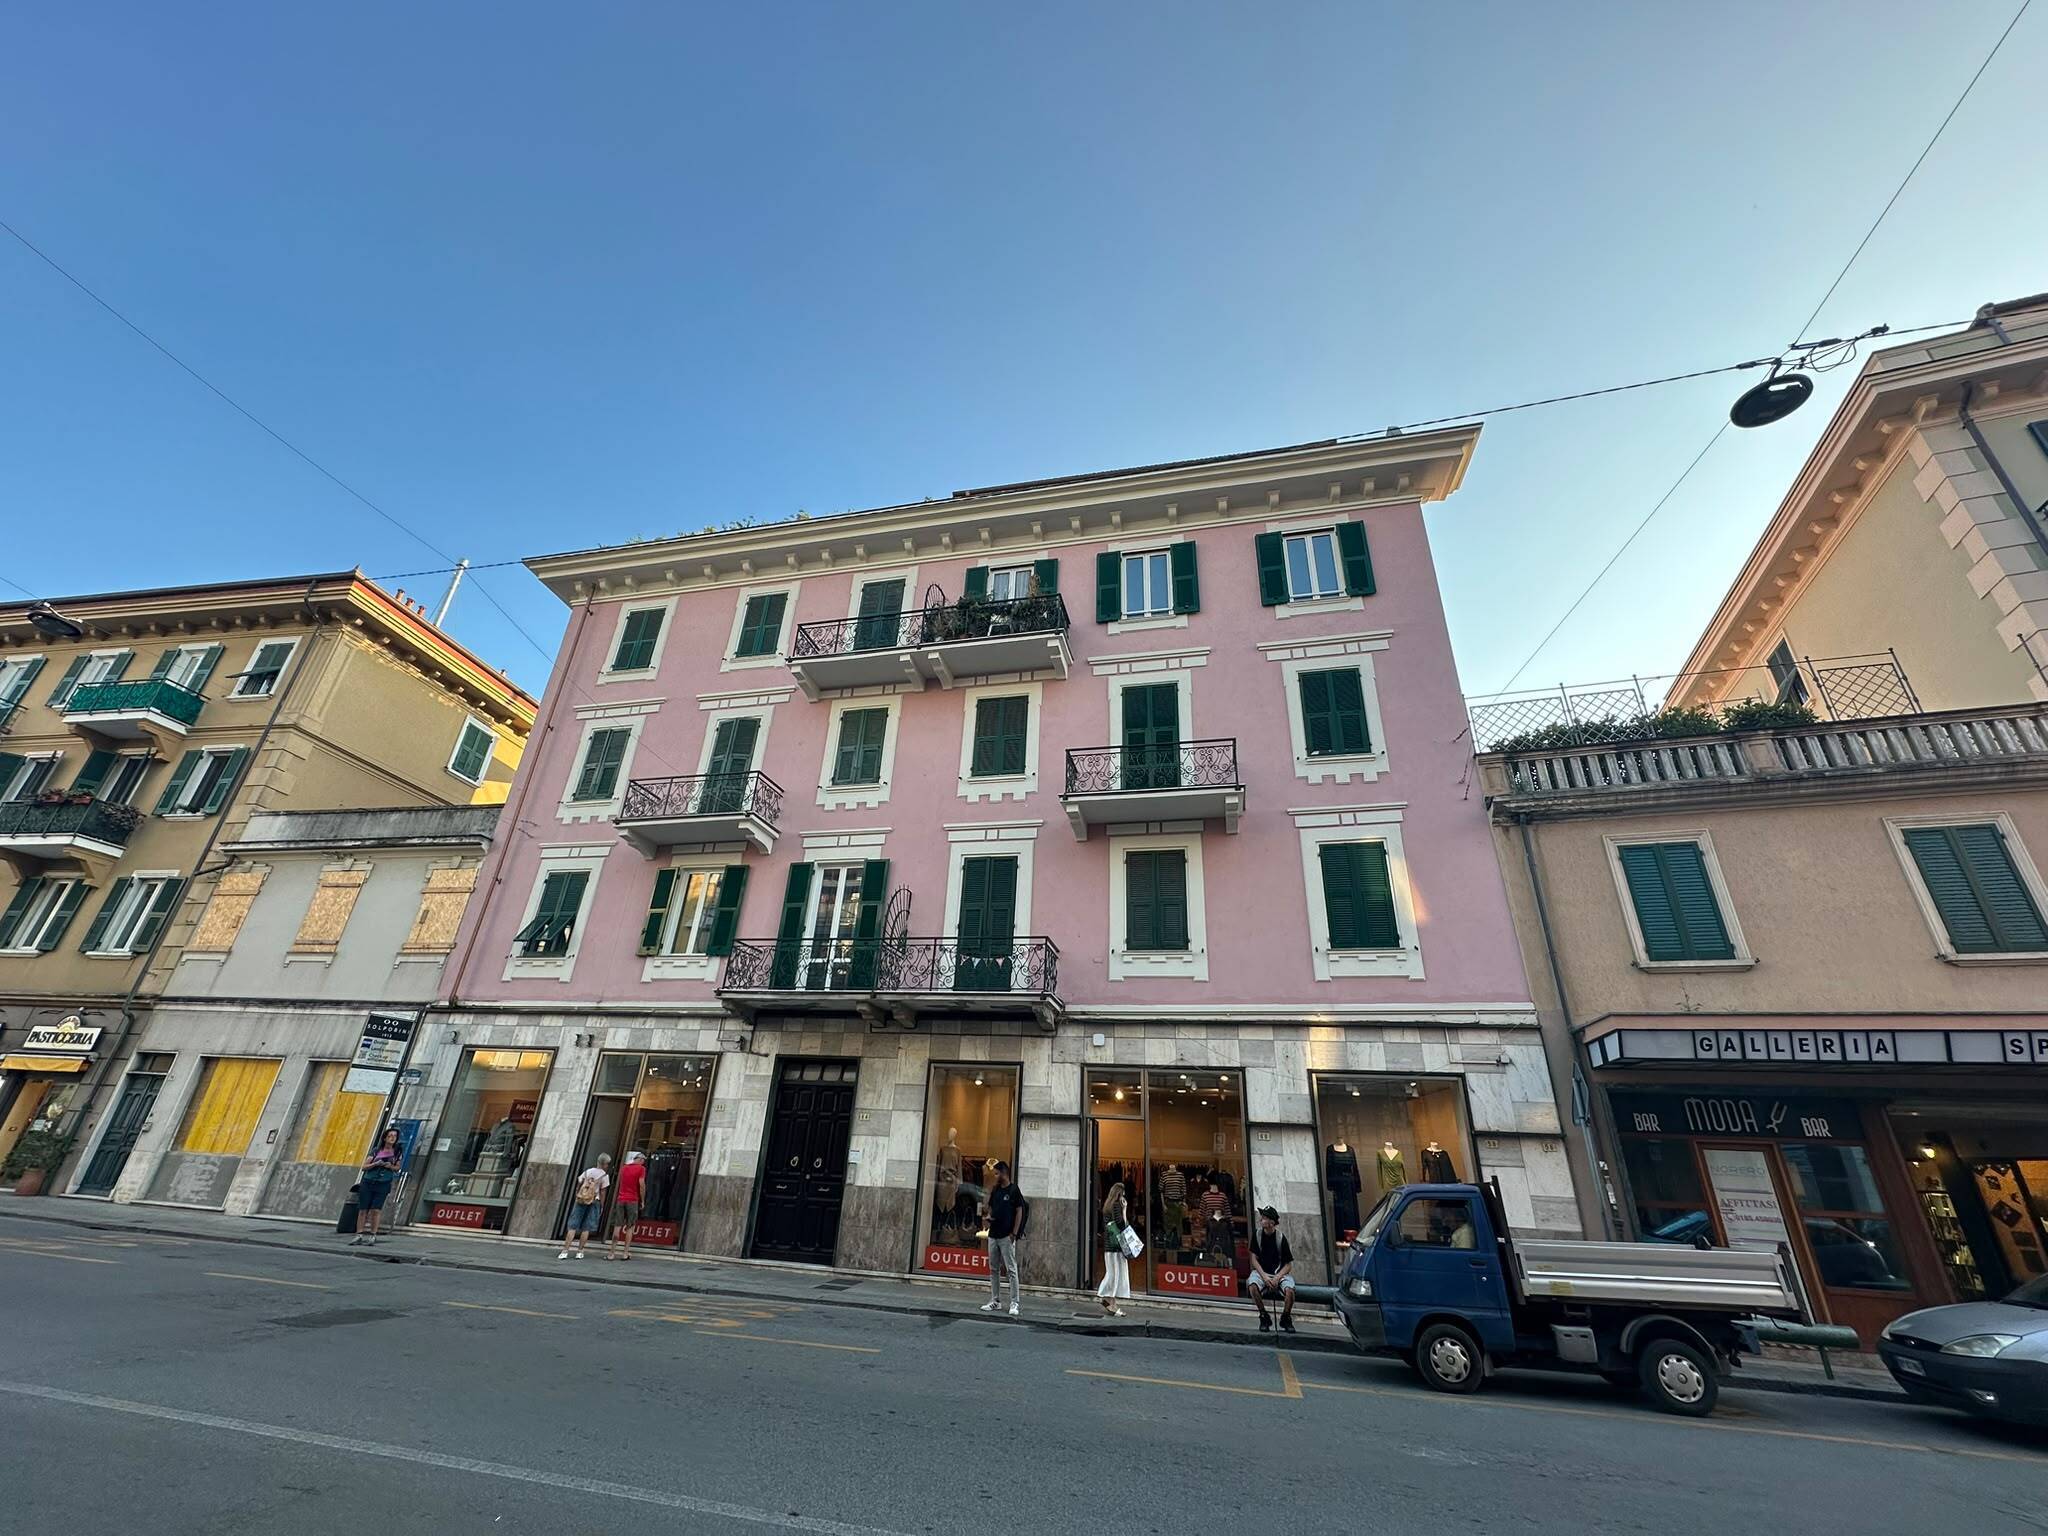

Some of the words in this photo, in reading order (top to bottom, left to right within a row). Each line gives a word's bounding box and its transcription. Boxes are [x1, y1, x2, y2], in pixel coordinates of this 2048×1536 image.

[28, 1031, 95, 1045] PASTICCERIA
[1699, 1037, 1889, 1054] GALLERIA
[1633, 1113, 1662, 1132] BAR
[1684, 1097, 1760, 1134] MODA
[1801, 1117, 1832, 1137] BAR
[437, 1209, 481, 1221] OUTLET
[930, 1251, 989, 1267] OUTLET
[1164, 1271, 1230, 1287] OUTLET
